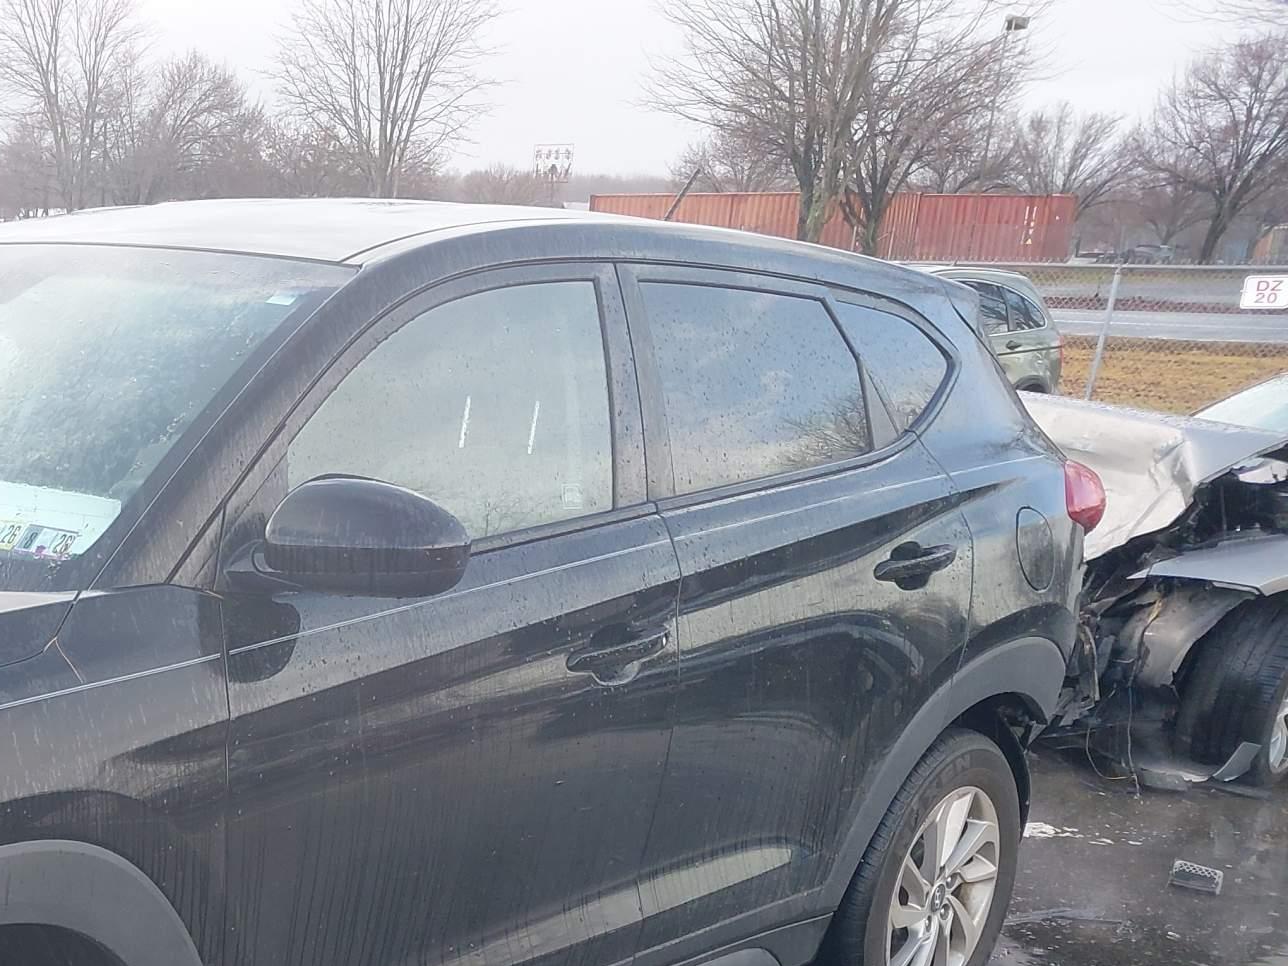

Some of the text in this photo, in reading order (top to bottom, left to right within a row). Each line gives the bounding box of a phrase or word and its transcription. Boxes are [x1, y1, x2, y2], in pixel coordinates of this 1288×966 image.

[1256, 280, 1284, 291] DZ
[1253, 292, 1277, 304] 20
[0, 524, 21, 544] 26
